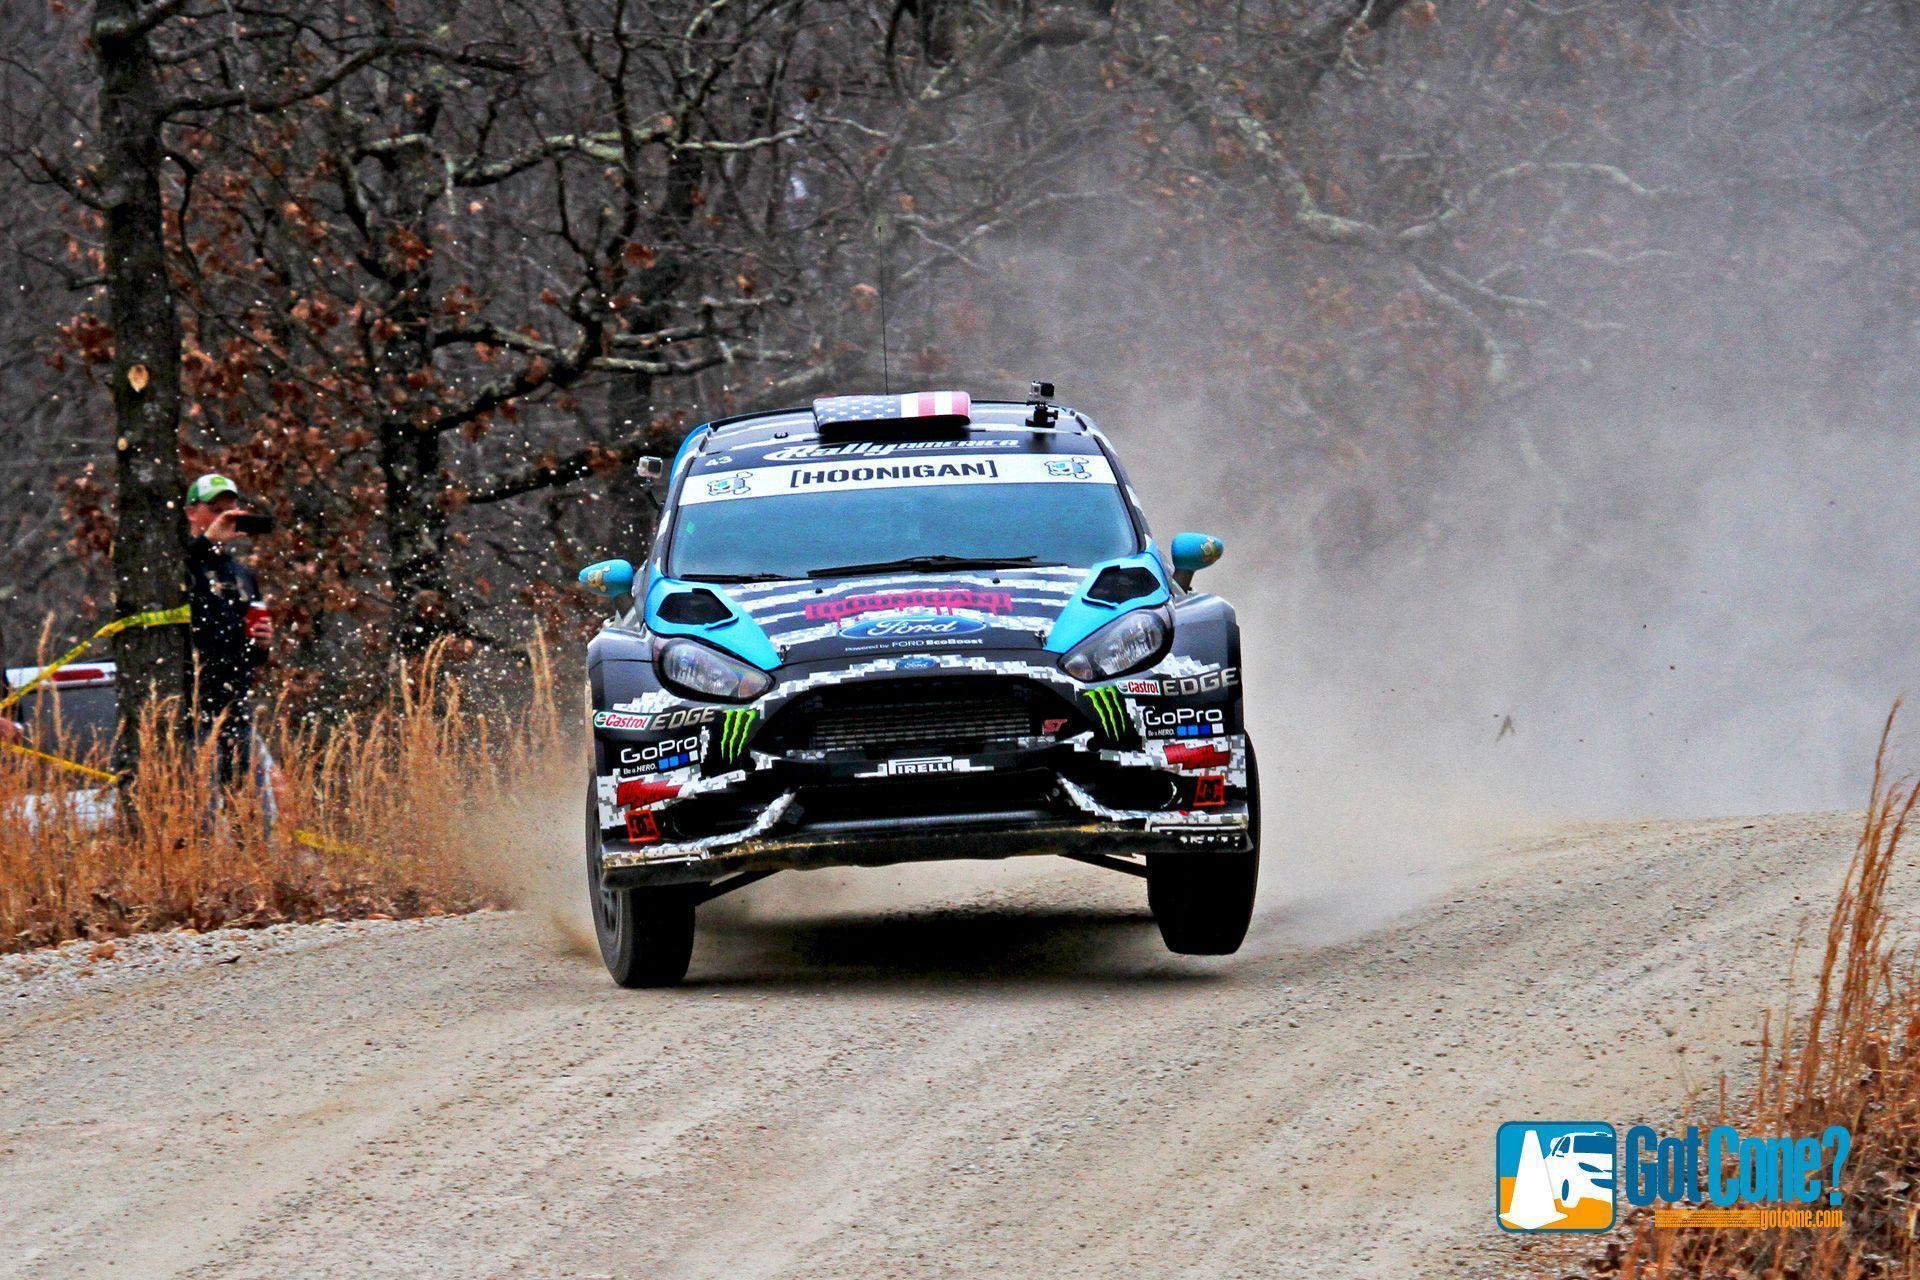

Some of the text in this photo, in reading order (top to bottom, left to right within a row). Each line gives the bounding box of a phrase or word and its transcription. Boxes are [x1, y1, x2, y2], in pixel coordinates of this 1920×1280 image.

[705, 455, 733, 466] 43
[867, 618, 959, 636] Ford
[926, 638, 984, 646] EcoBoost
[1128, 667, 1239, 696] Castrol EDGE
[605, 707, 717, 730] Castrol EDGE
[1145, 708, 1223, 726] GoPro
[620, 736, 698, 764] GoPro
[888, 756, 953, 775] PIRELLI
